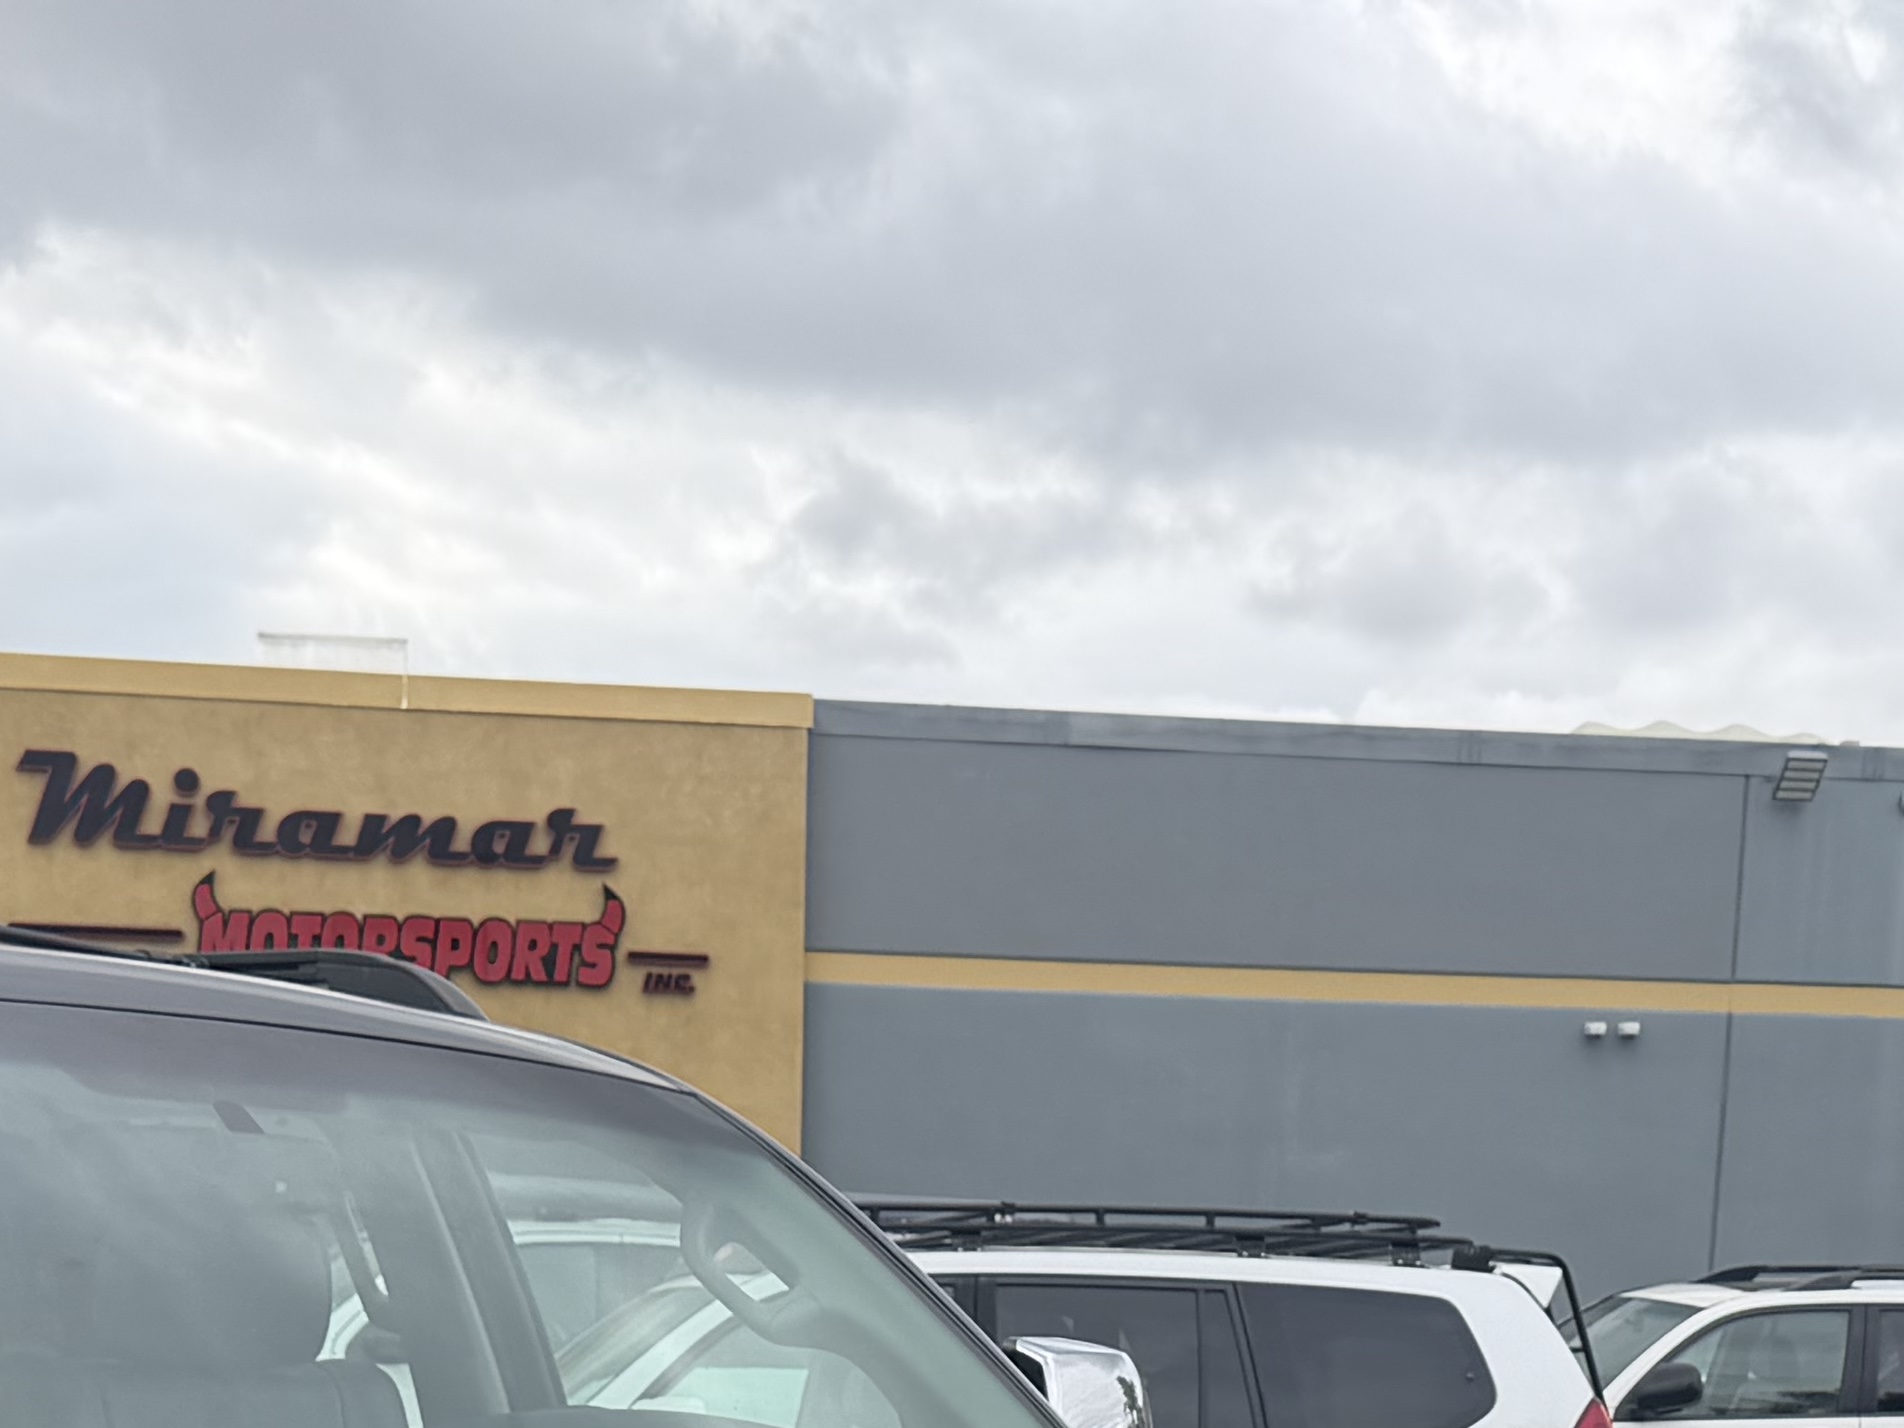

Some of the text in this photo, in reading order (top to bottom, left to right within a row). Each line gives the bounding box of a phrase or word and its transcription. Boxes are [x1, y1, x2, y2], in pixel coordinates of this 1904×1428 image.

[14, 747, 620, 873] Miramar
[198, 908, 617, 988] MOTORSPORTS
[641, 971, 695, 995] INC.
